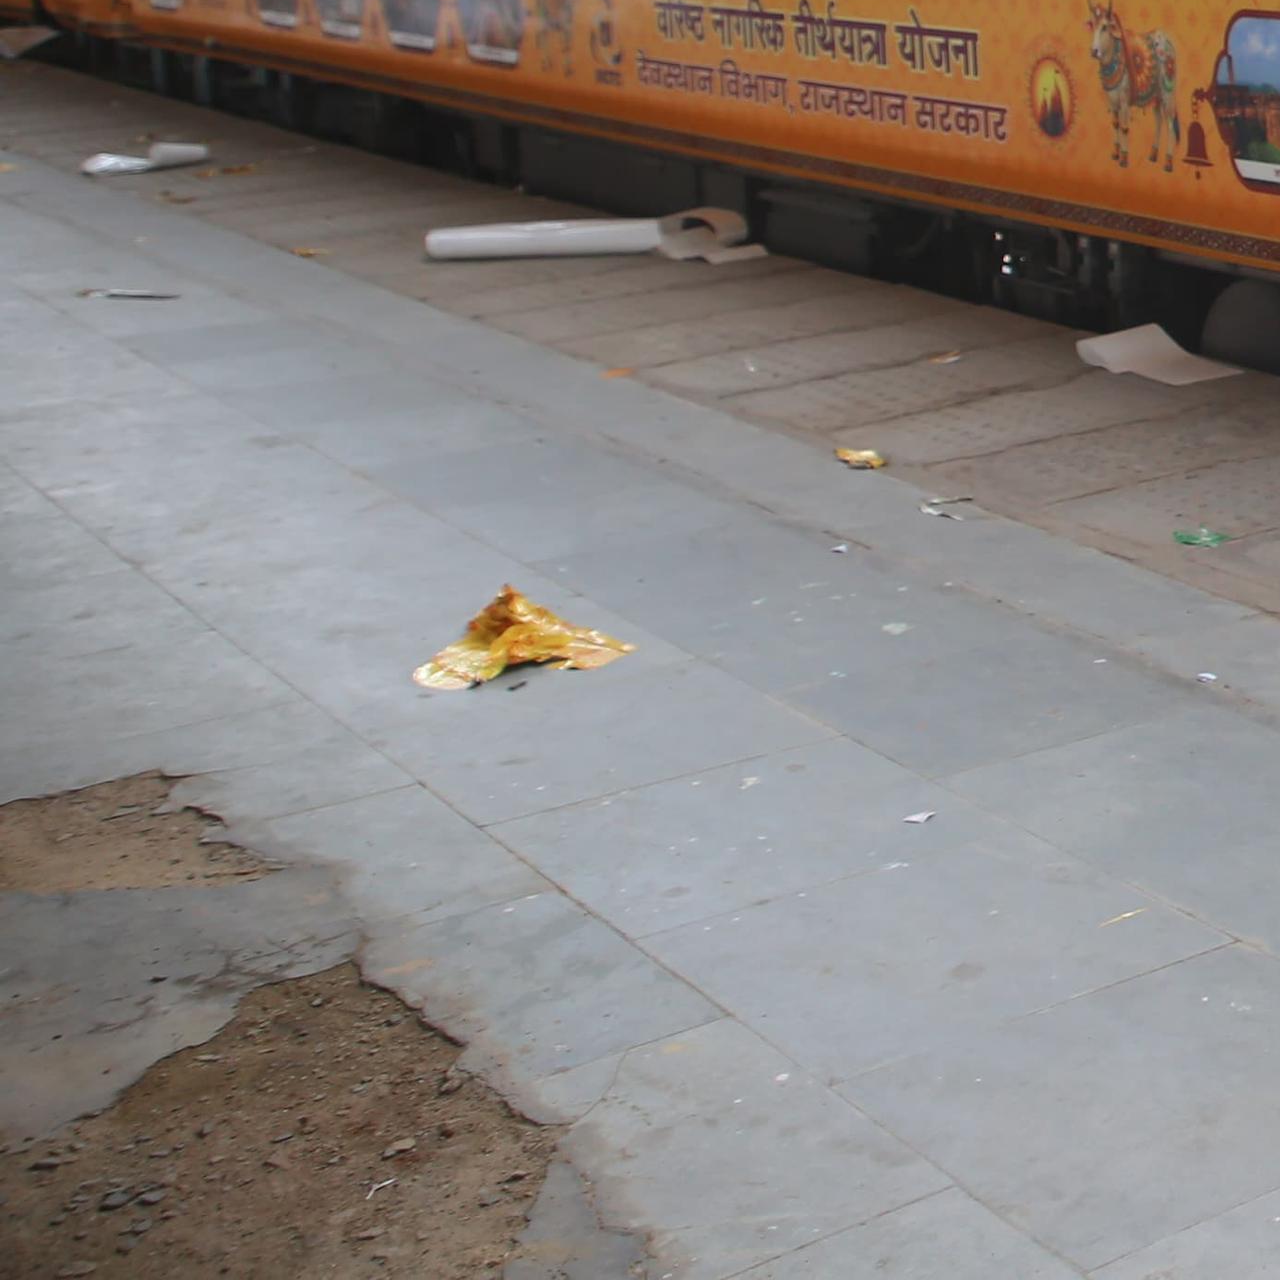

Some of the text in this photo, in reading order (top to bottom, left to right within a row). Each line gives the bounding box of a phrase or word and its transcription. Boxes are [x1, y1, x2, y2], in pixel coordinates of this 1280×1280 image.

[792, 0, 888, 67] तीर्थयात्रा
[895, 10, 979, 78] योजना
[636, 50, 1008, 142] देवस्थान विभाग, राजस्थान सरकार
